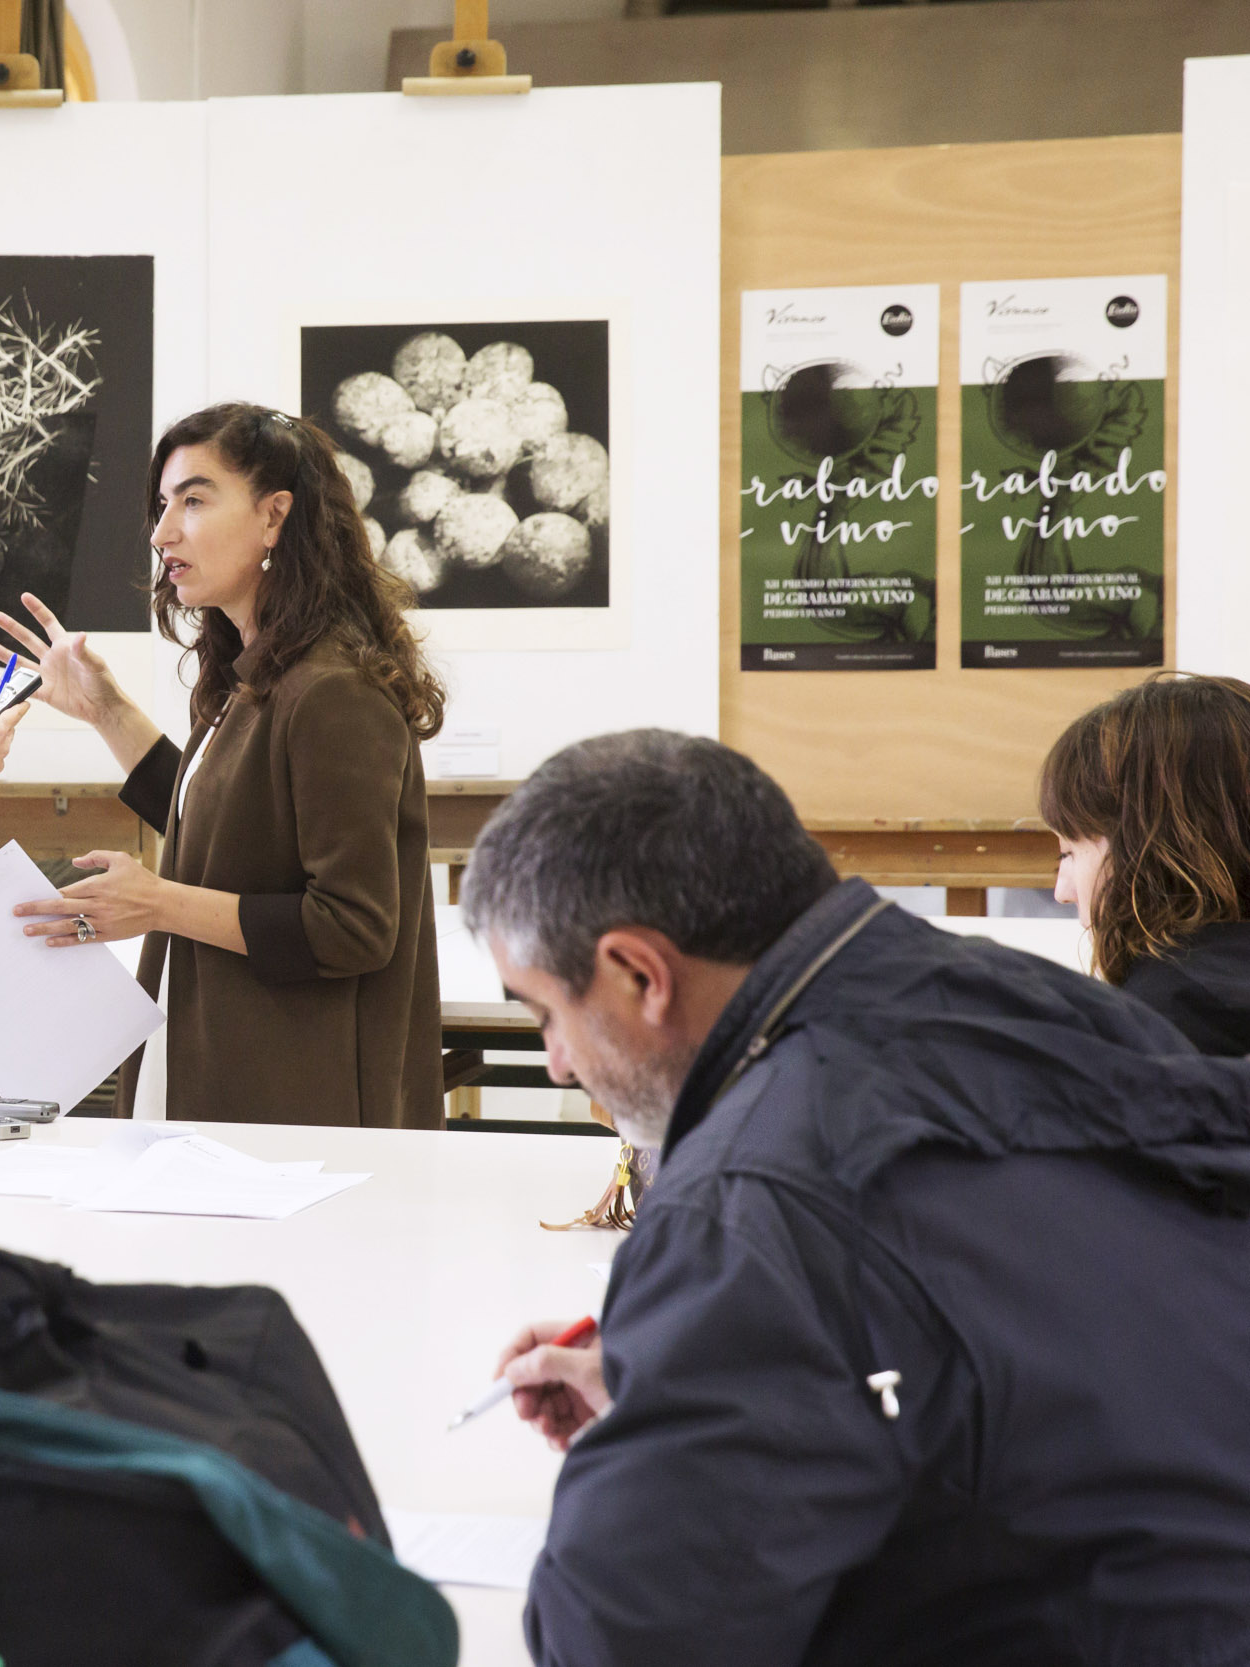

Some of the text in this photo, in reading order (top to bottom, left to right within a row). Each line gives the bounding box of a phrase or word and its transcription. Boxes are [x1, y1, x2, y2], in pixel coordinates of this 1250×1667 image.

[740, 452, 940, 507] rabado
[960, 446, 1167, 502] rabado
[780, 510, 913, 546] vino
[1001, 504, 1140, 540] vino
[782, 578, 825, 589] PREMIO
[826, 576, 914, 589] INTERNACIONAL
[1004, 575, 1049, 586] PREMIO
[1050, 572, 1141, 585] INTERNACIONAL
[763, 589, 916, 606] DE GRABADO Y VINO
[984, 584, 1142, 603] DE GRABADO Y VINO
